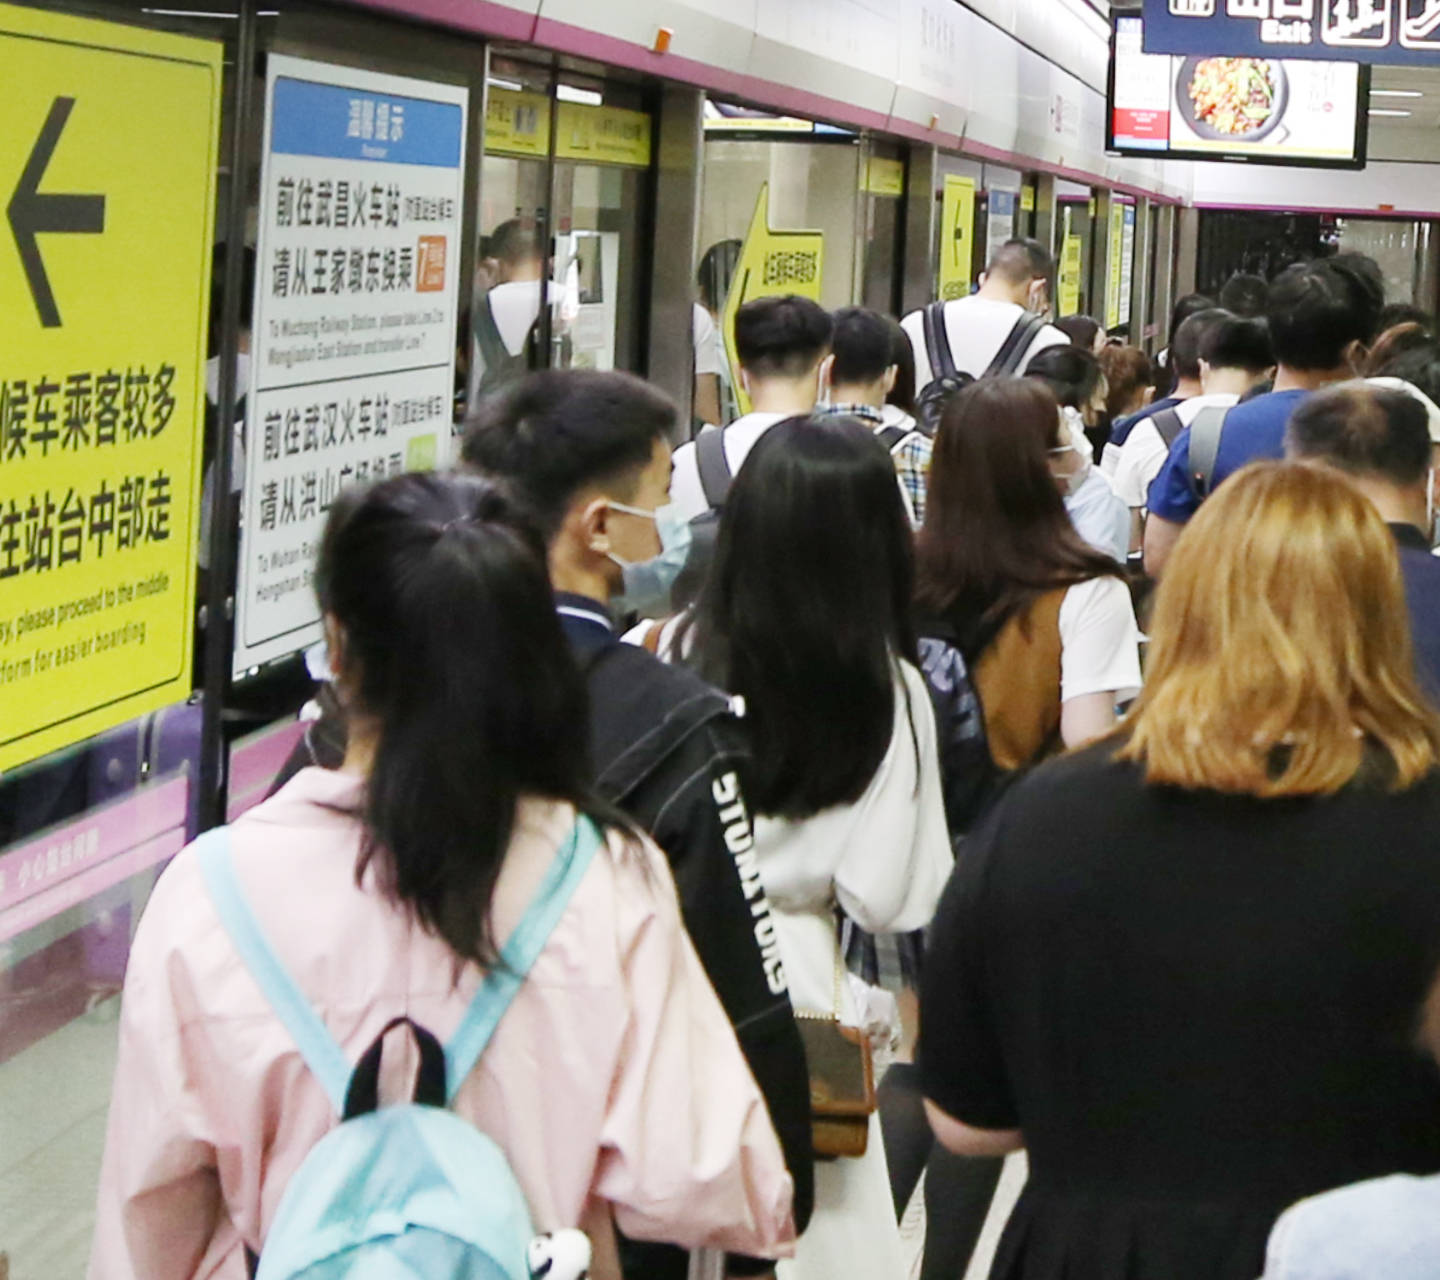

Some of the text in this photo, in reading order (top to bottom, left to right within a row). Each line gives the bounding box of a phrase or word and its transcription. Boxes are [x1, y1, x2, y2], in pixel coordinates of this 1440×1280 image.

[1260, 18, 1312, 45] Exit
[276, 177, 401, 229] 前往武昌火车站
[263, 392, 389, 462] 前往武汉火车站
[16, 607, 55, 637] please
[58, 589, 102, 629] proceed
[105, 588, 116, 609] to
[118, 581, 134, 604] the
[136, 571, 169, 599] middle
[34, 649, 54, 674] for
[56, 640, 92, 667] easier
[94, 621, 147, 654] boarding
